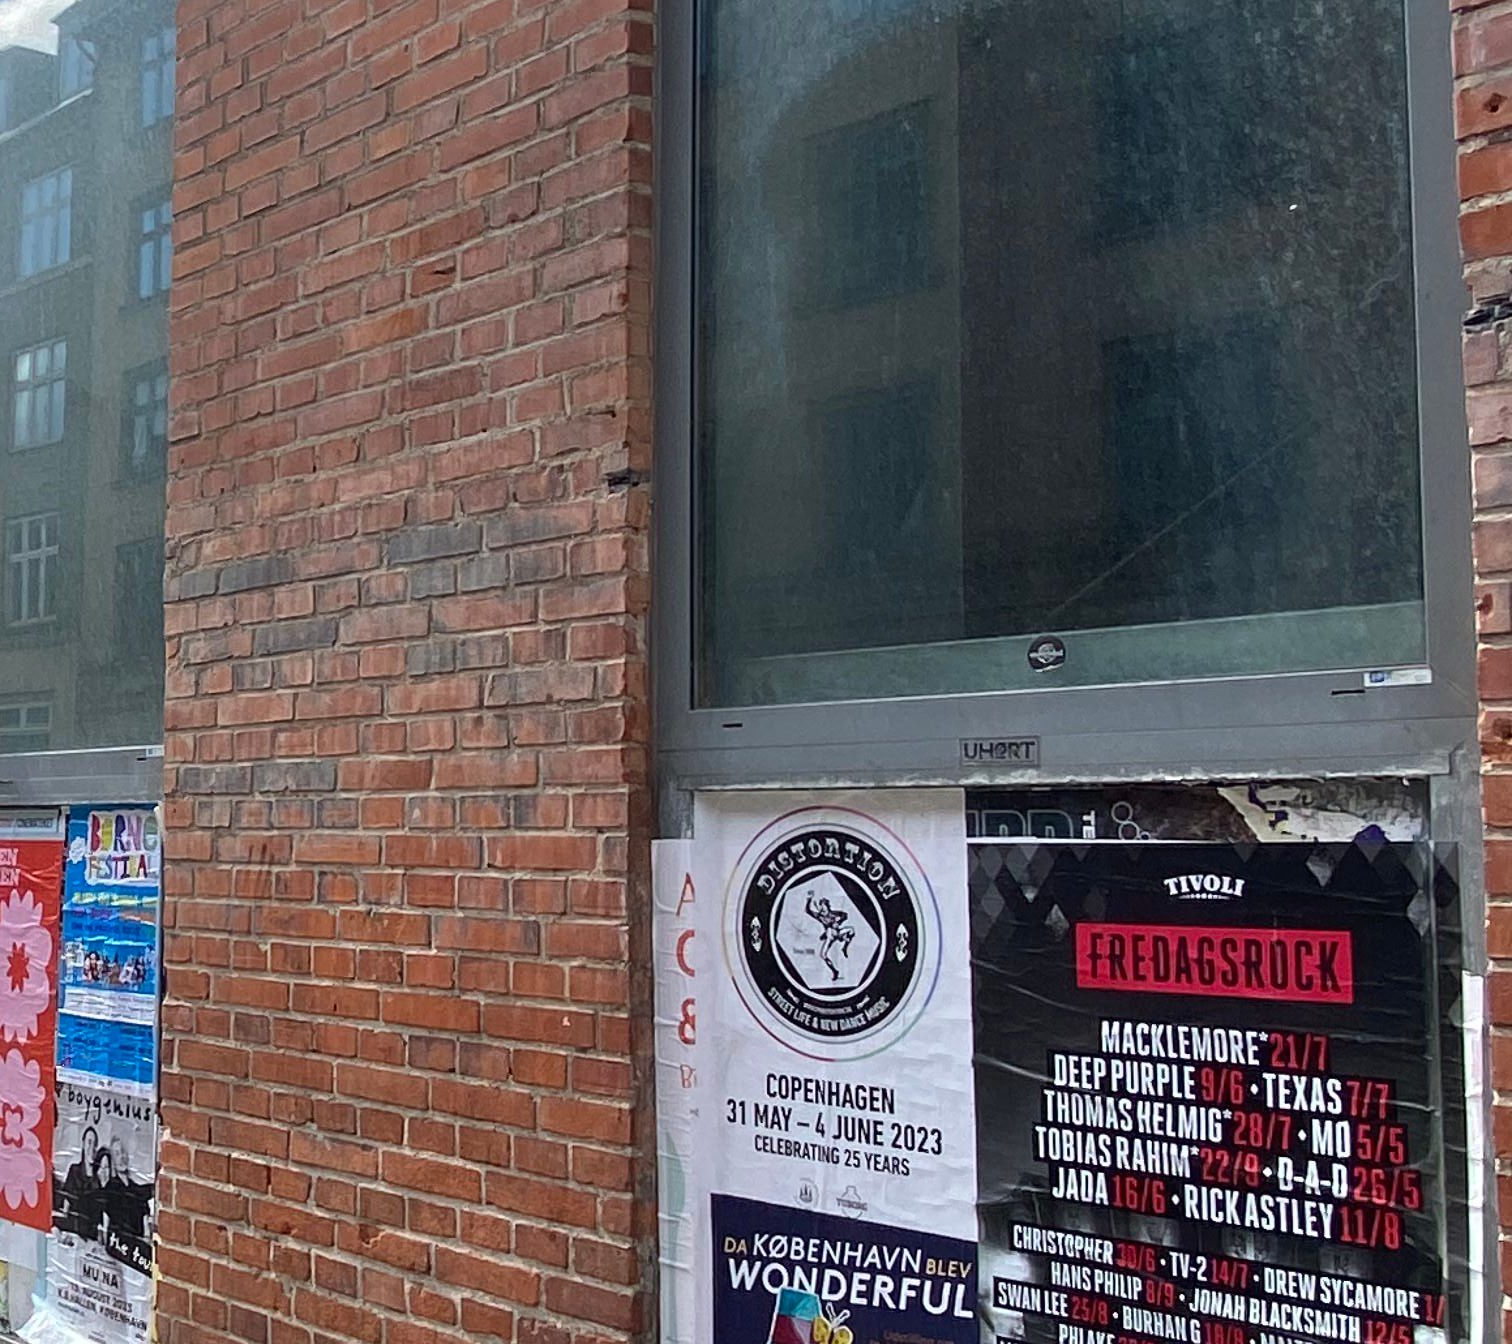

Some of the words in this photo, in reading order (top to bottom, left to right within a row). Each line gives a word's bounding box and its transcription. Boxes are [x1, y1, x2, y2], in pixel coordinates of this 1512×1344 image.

[756, 838, 901, 900] DISTORTION
[1164, 873, 1246, 898] TIVOLI
[1087, 931, 1342, 994] FREDAGSROCK
[768, 987, 795, 1015] STREET
[793, 1009, 812, 1026] LIFE
[812, 1017, 819, 1029] &
[820, 1018, 839, 1031] NEW
[839, 1013, 866, 1031] DANCE
[864, 996, 890, 1021] MUSIC
[1269, 1032, 1328, 1072] 21/7
[68, 1083, 151, 1125] boygenius
[766, 1073, 895, 1114] COPENHAGEN
[1054, 1053, 1107, 1091] DEEP
[1111, 1059, 1196, 1101] PURPLE
[1201, 1066, 1244, 1105] 9/6
[1262, 1072, 1343, 1116] TEXAS
[1347, 1080, 1389, 1120] 7/7
[727, 1099, 746, 1126] 31
[754, 1104, 792, 1133] MAY
[815, 1112, 826, 1139] 4
[832, 1114, 884, 1147] JUNE
[890, 1122, 943, 1155] 2023
[754, 1135, 839, 1165] CELEBRATING
[844, 1149, 861, 1169] 25
[863, 1153, 910, 1176] YEARS
[1043, 1089, 1135, 1134] THOMAS
[1233, 1111, 1291, 1151] 28/7
[1357, 1123, 1405, 1164] 5/5
[1035, 1126, 1111, 1169] TOBIAS
[1200, 1148, 1260, 1188] 22/9
[1278, 1156, 1348, 1199] D-A-D
[1353, 1167, 1420, 1209] 26/5
[1052, 1167, 1109, 1207] JADA
[1112, 1176, 1166, 1215] 16/6
[1185, 1184, 1243, 1224] RICK
[1245, 1193, 1333, 1239] ASTLEY
[1339, 1205, 1400, 1250] 11/8
[724, 1236, 748, 1255] DA
[752, 1233, 922, 1274] KØBENHAVN
[925, 1258, 972, 1279] BLEV
[1013, 1224, 1114, 1266] CHRISTOPHER
[1169, 1251, 1208, 1282] TV-2
[1210, 1258, 1248, 1289] 14/7
[1263, 1267, 1316, 1301] DREW
[1320, 1277, 1421, 1320] SYCAMORE
[1423, 1294, 1446, 1325] 1/
[728, 1258, 974, 1319] WONDERFUL
[998, 1281, 1041, 1313] SWAN
[1044, 1289, 1069, 1318] LEE
[1071, 1294, 1108, 1325] 25/8
[1122, 1305, 1188, 1342] BURHAN
[1189, 1318, 1202, 1344] G
[1051, 1261, 1092, 1292] HANS
[1094, 1269, 1143, 1301] PHILIP
[1145, 1279, 1175, 1307] 8/9
[1189, 1288, 1246, 1322] JONAH
[1249, 1295, 1361, 1343] BLACKSMITH
